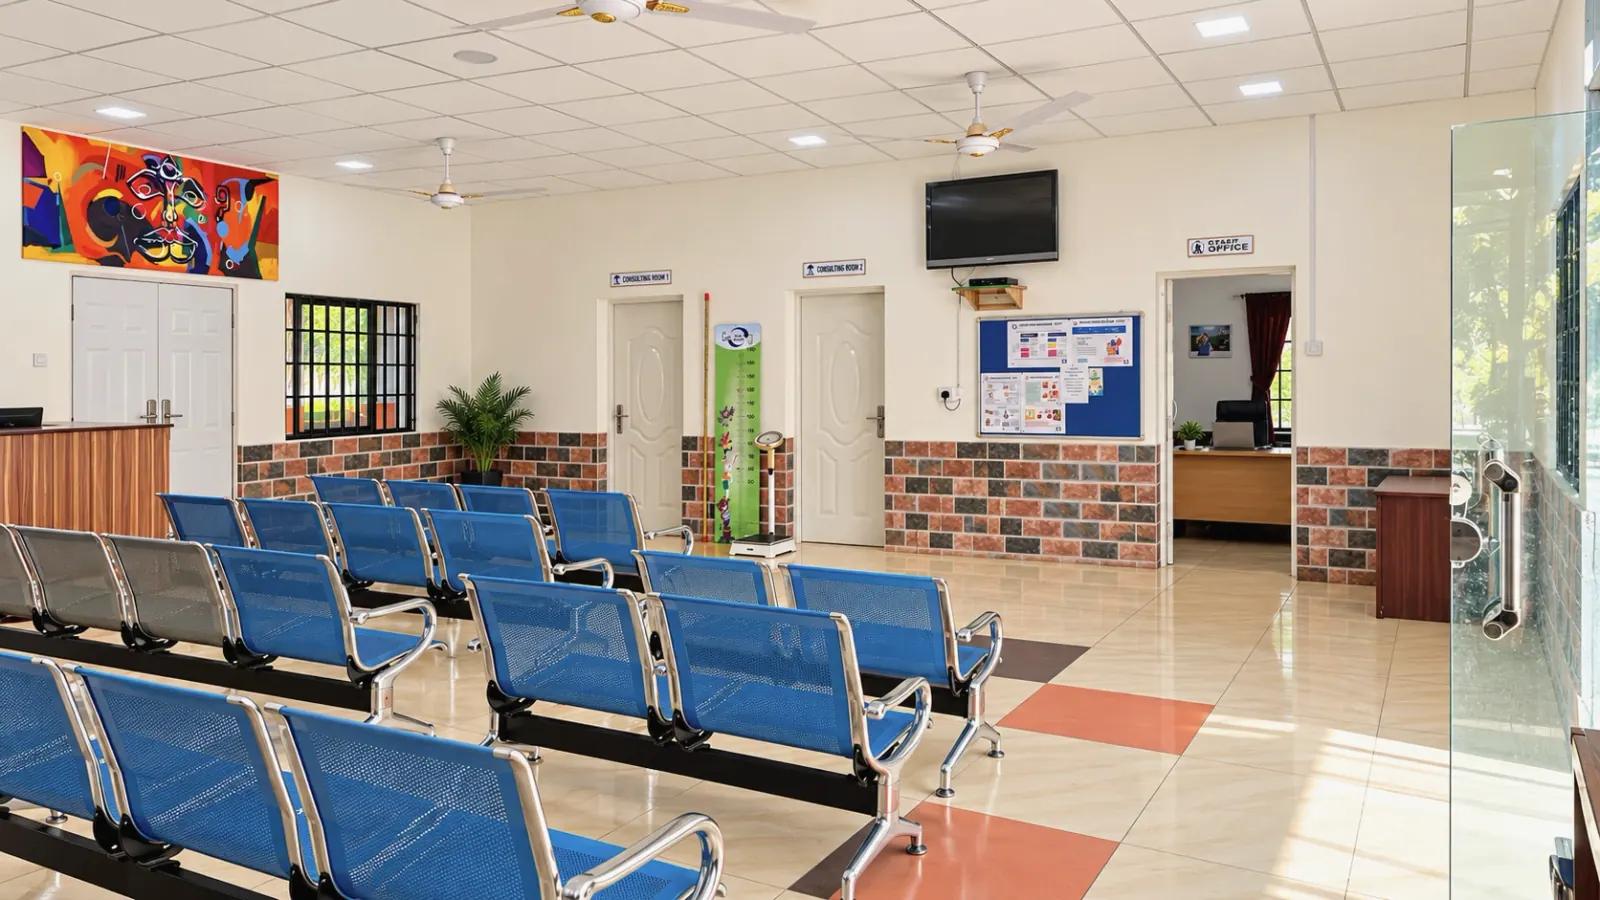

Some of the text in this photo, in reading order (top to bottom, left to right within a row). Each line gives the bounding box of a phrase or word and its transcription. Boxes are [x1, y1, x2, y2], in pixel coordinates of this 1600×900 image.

[1208, 243, 1248, 252] OFFICE
[817, 264, 844, 273] CONSULTING
[845, 264, 858, 272] ROOM
[623, 275, 651, 283] CONSULTING
[652, 273, 665, 281] ROOM
